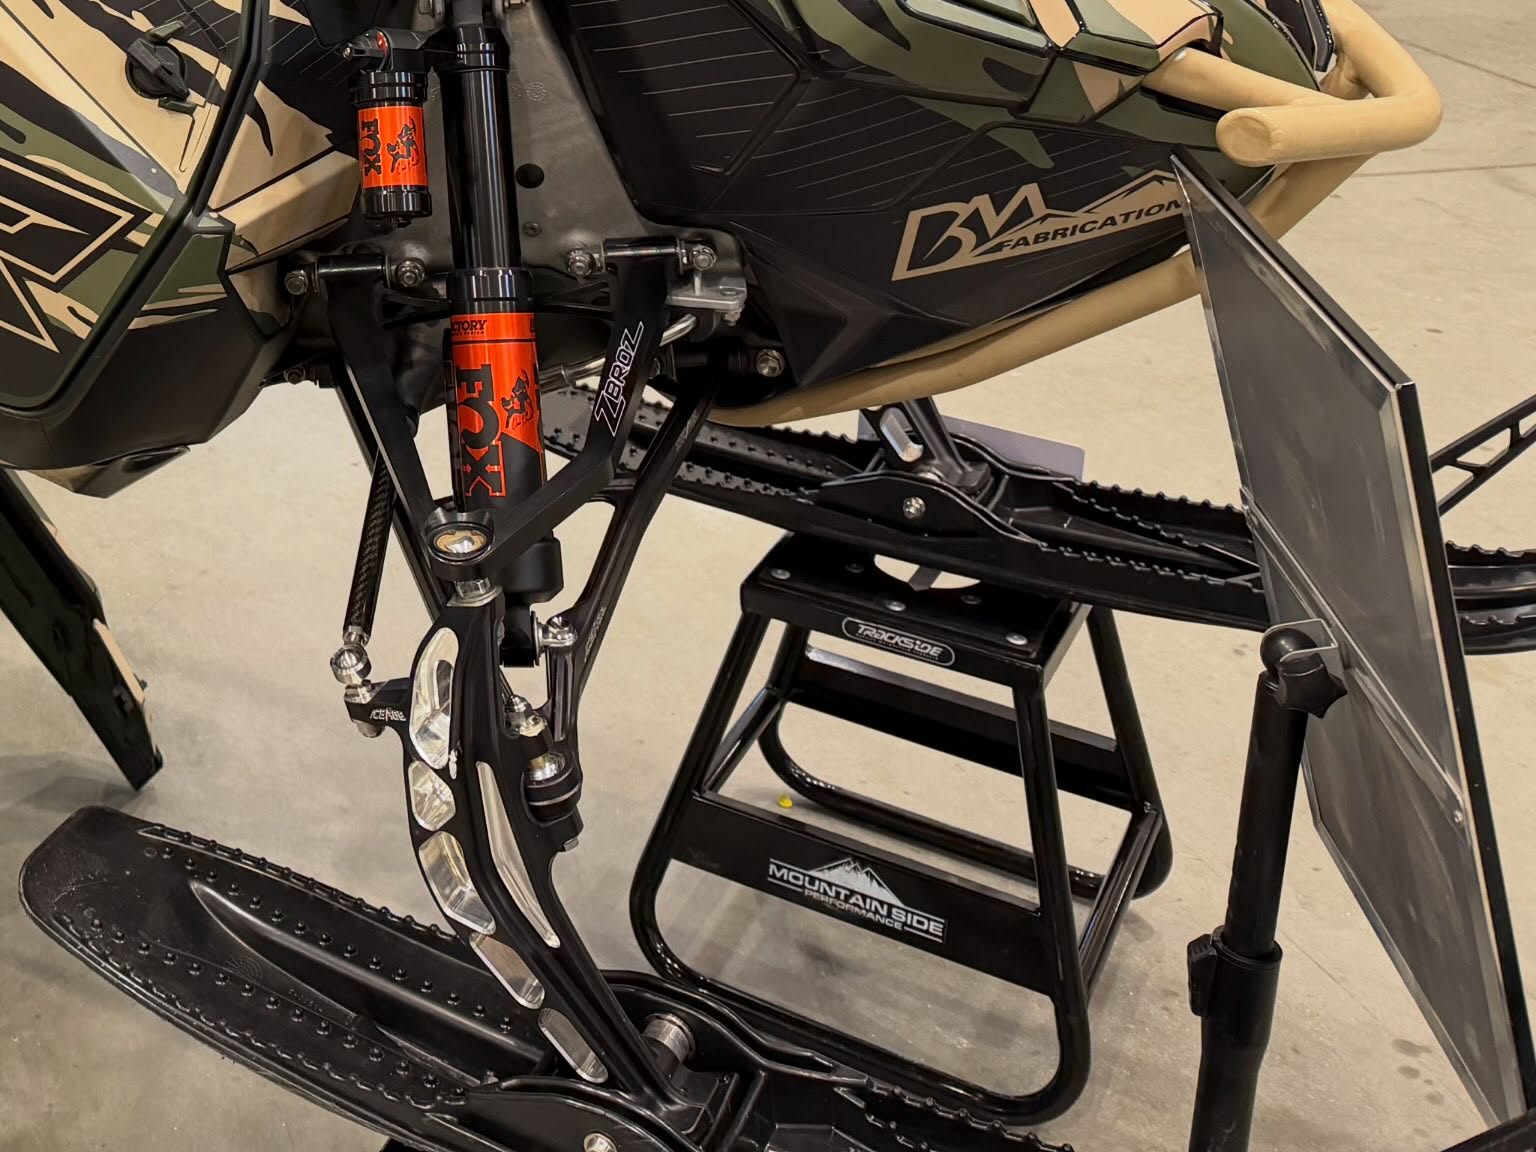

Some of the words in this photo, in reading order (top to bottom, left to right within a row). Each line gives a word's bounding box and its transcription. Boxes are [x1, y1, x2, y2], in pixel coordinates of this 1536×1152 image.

[359, 120, 382, 177] FOX
[456, 364, 506, 498] FOX
[768, 862, 888, 916] MOUNTAIN
[891, 906, 945, 937] SIDE
[804, 888, 904, 931] PERFORMANCE
